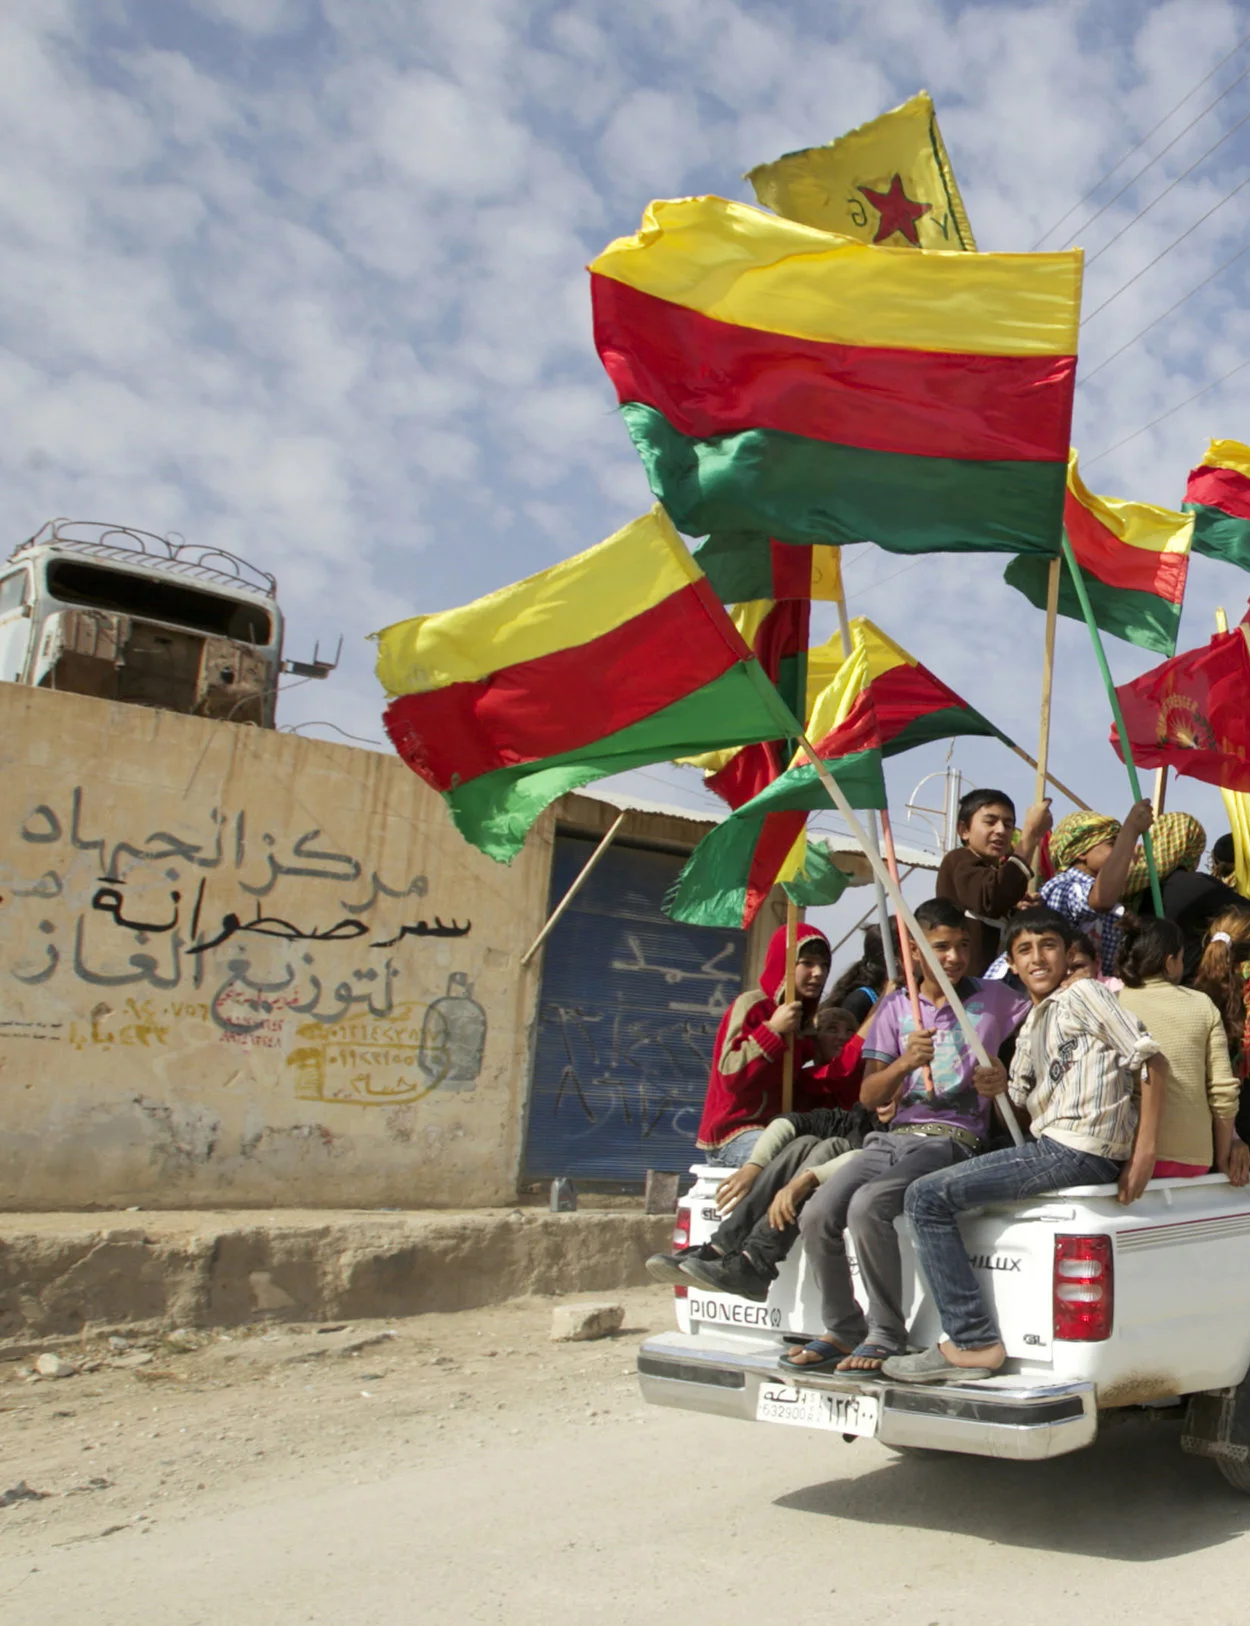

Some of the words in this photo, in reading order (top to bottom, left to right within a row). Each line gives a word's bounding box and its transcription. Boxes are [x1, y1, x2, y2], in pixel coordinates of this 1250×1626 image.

[21, 785, 245, 880] الجهاد
[238, 828, 428, 914] مركز
[11, 912, 204, 990] الغاز
[210, 950, 396, 1033] لتوزيع
[701, 1207, 722, 1221] GL
[690, 1299, 769, 1326] PIONEER
[1023, 1334, 1047, 1347] GL
[762, 1403, 806, 1420] 632900
